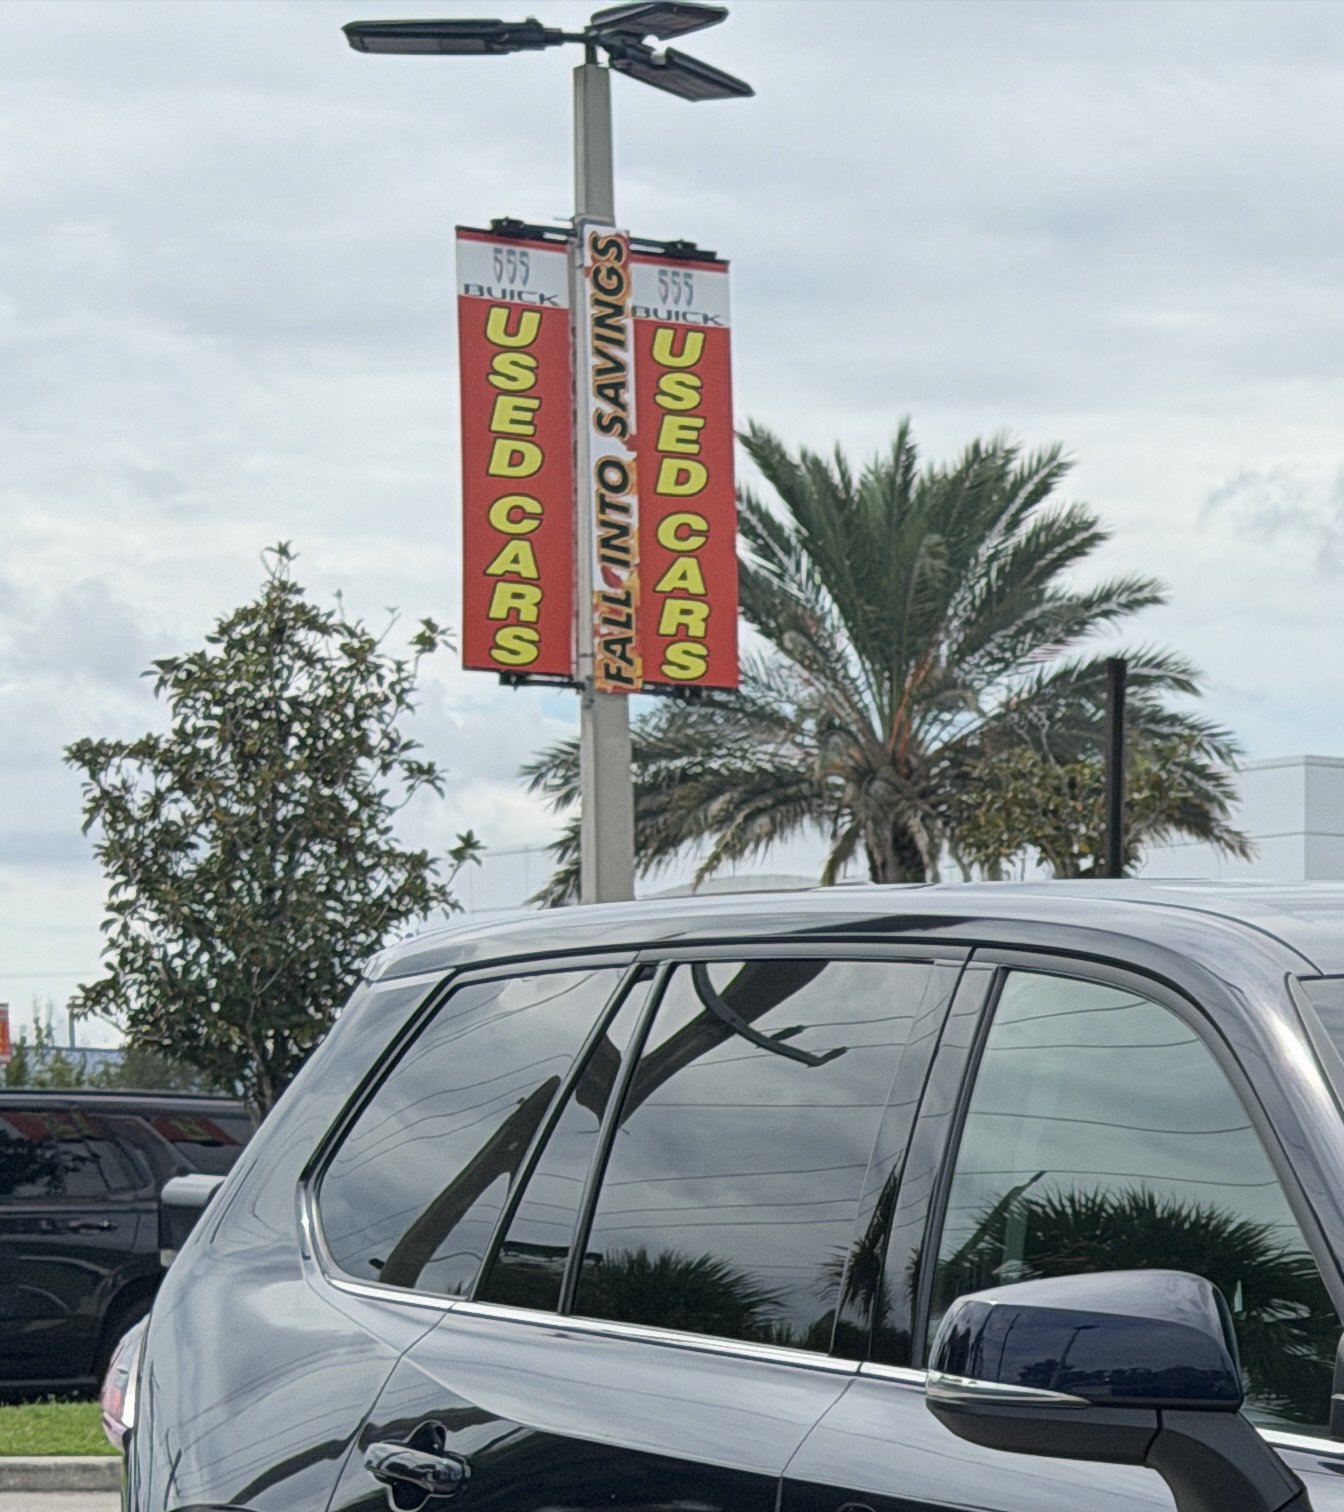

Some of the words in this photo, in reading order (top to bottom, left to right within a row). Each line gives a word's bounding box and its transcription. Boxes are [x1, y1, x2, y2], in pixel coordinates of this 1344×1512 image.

[463, 283, 561, 307] BUICK
[590, 232, 631, 441] SAVINGS
[632, 305, 725, 327] BUICK
[485, 306, 545, 479] USED
[651, 327, 708, 497] USED
[485, 493, 544, 666] CARS
[594, 456, 635, 572] INTO
[654, 512, 710, 681] CARS
[598, 588, 637, 687] FALL
